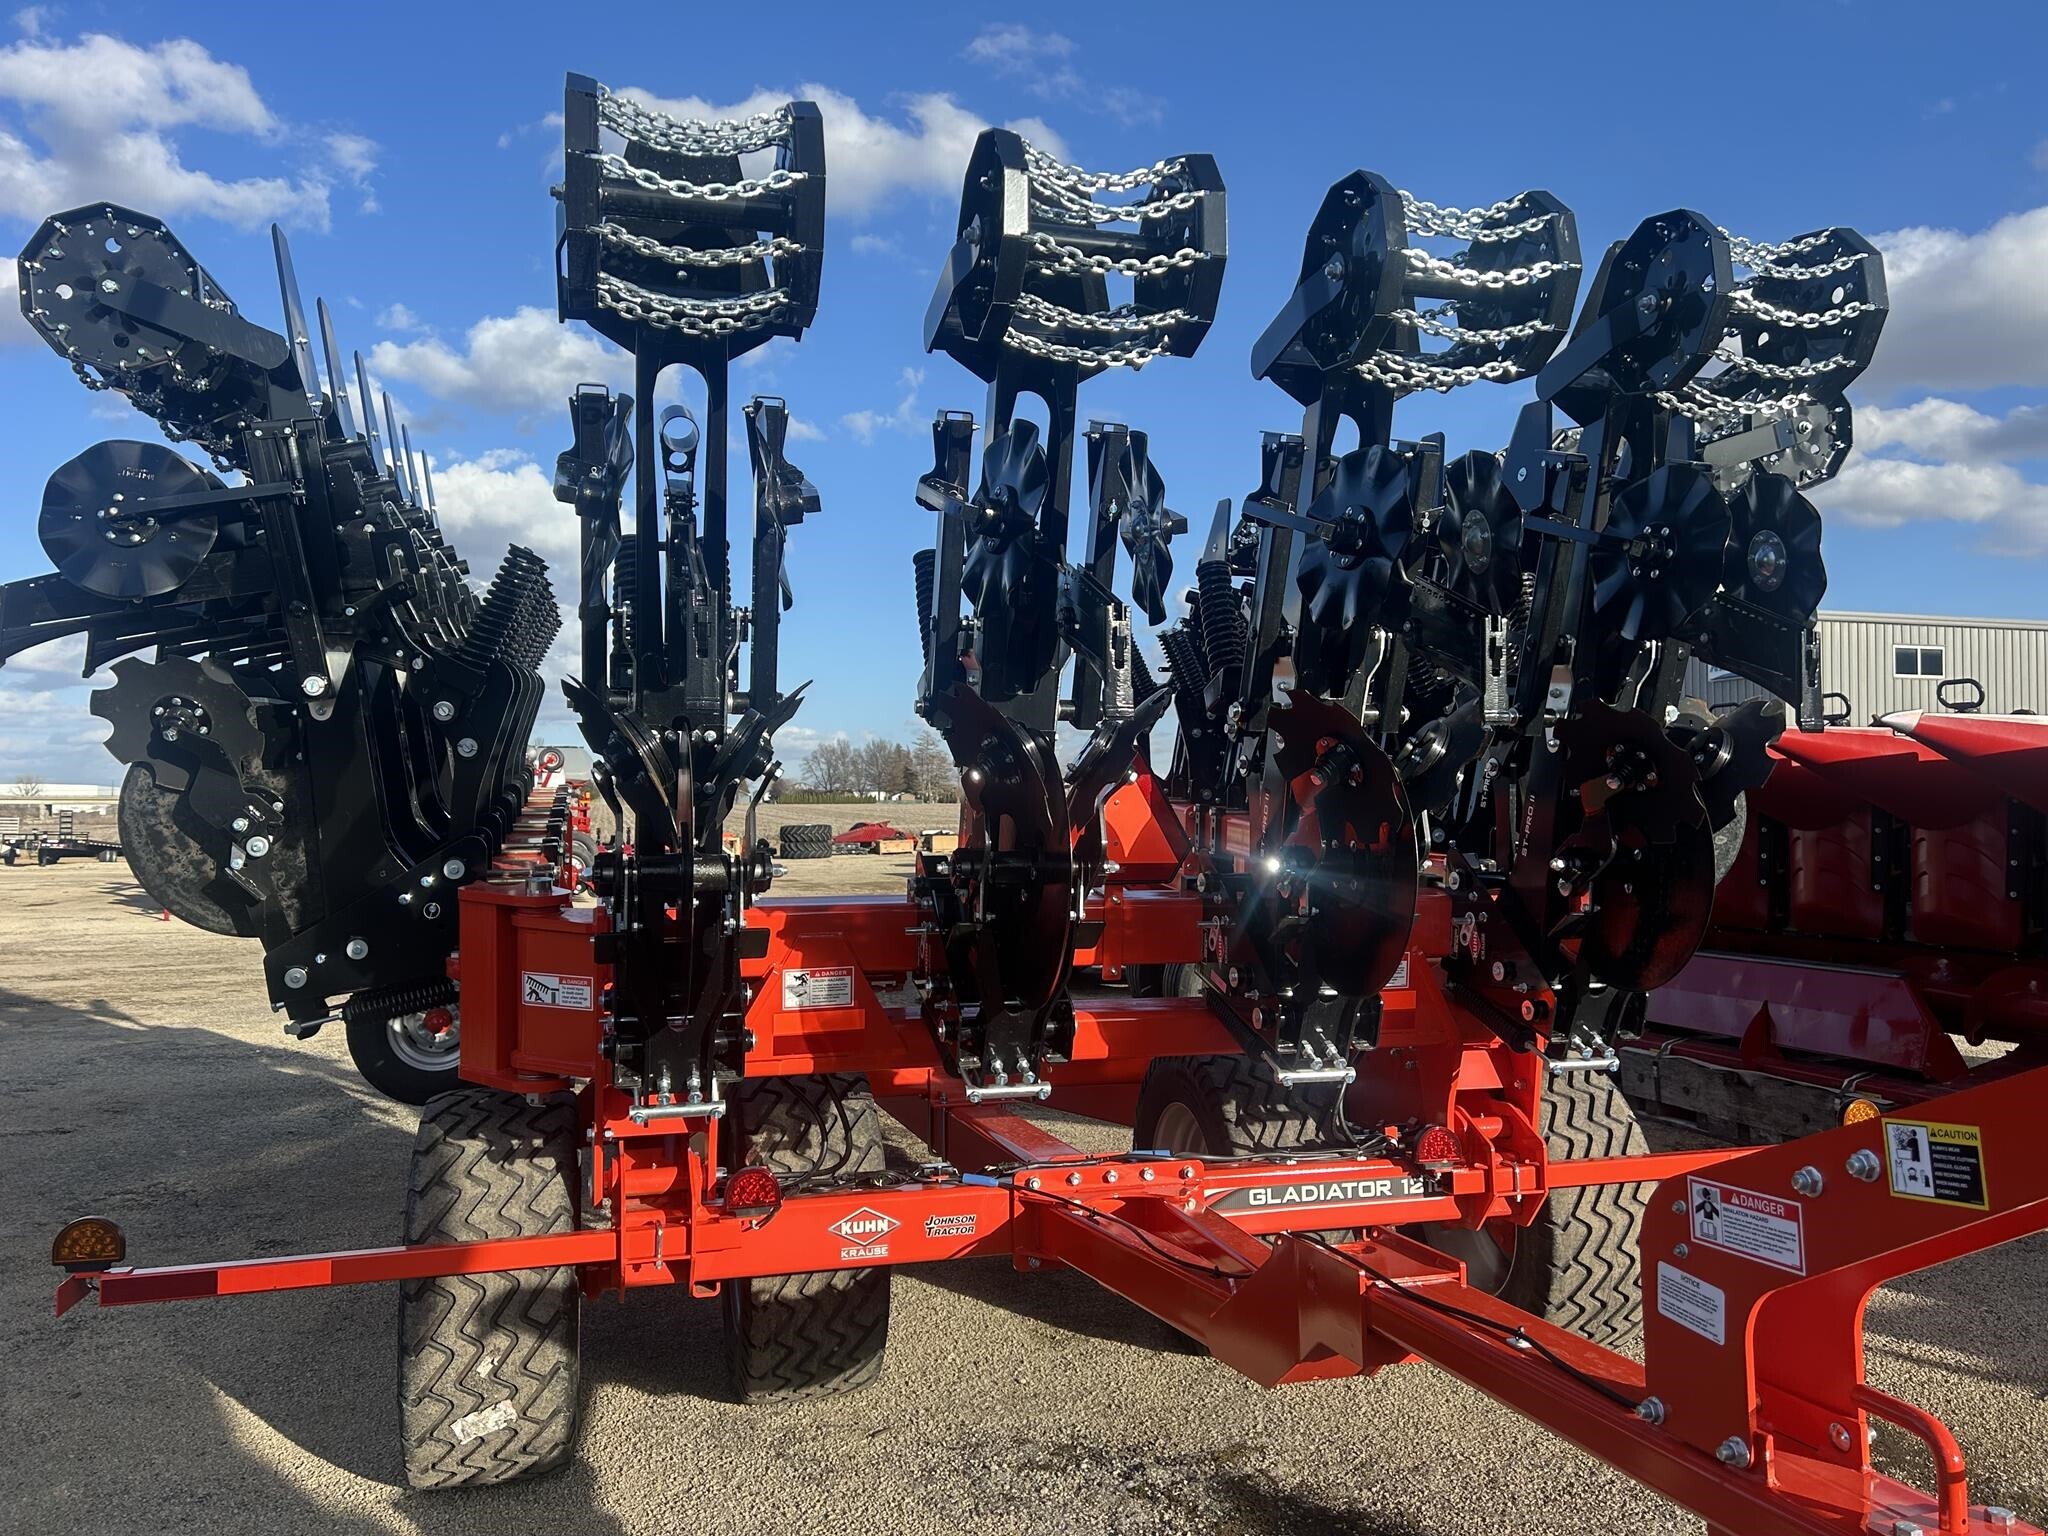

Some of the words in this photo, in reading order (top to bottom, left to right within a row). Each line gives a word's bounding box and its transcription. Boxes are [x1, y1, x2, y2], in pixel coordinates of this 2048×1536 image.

[1521, 806, 1534, 856] ST-PRO
[1937, 1128, 1977, 1141] CAUTION
[1249, 1179, 1392, 1206] GLADIATOR
[1740, 1195, 1785, 1217] DANGER
[841, 1219, 889, 1236] KUHN
[925, 1215, 976, 1227] JOHNSON
[926, 1225, 975, 1237] TRACTOR
[841, 1246, 888, 1258] KRAUSE
